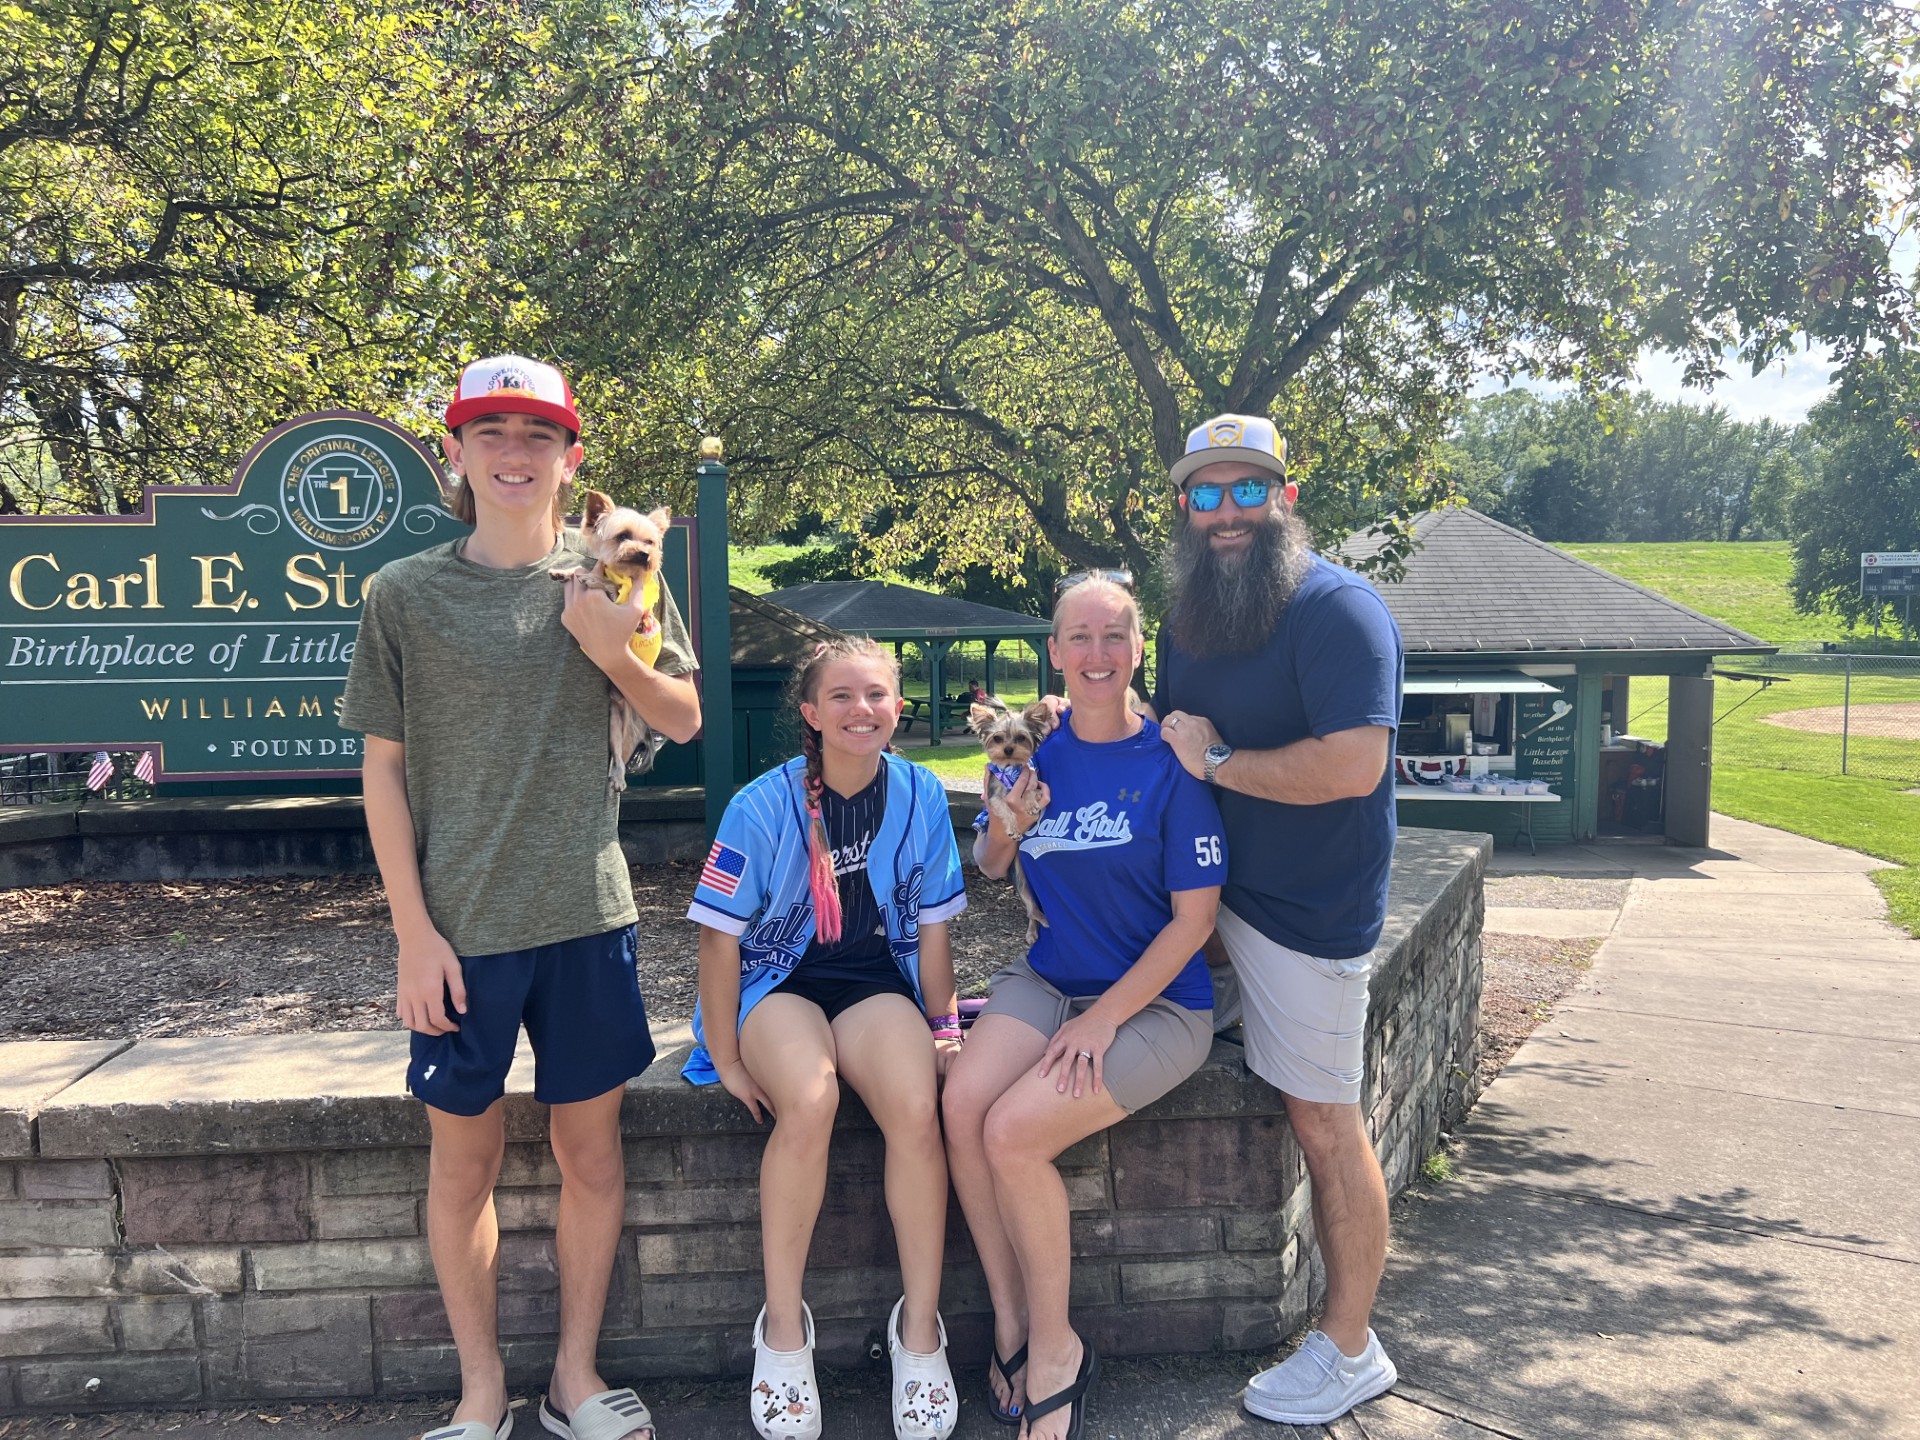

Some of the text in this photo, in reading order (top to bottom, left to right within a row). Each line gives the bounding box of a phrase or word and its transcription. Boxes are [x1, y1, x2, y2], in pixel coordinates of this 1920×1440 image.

[287, 440, 396, 490] THE ORIGINAL LEAGUE
[313, 480, 329, 489] THE
[9, 552, 165, 611] Carl
[190, 551, 260, 613] E.
[5, 632, 356, 674] Birthplace of Little
[231, 737, 366, 758] FOUNDE
[1523, 748, 1545, 756] Little
[1032, 841, 1068, 855] BASEBALL
[1194, 835, 1222, 867] 56
